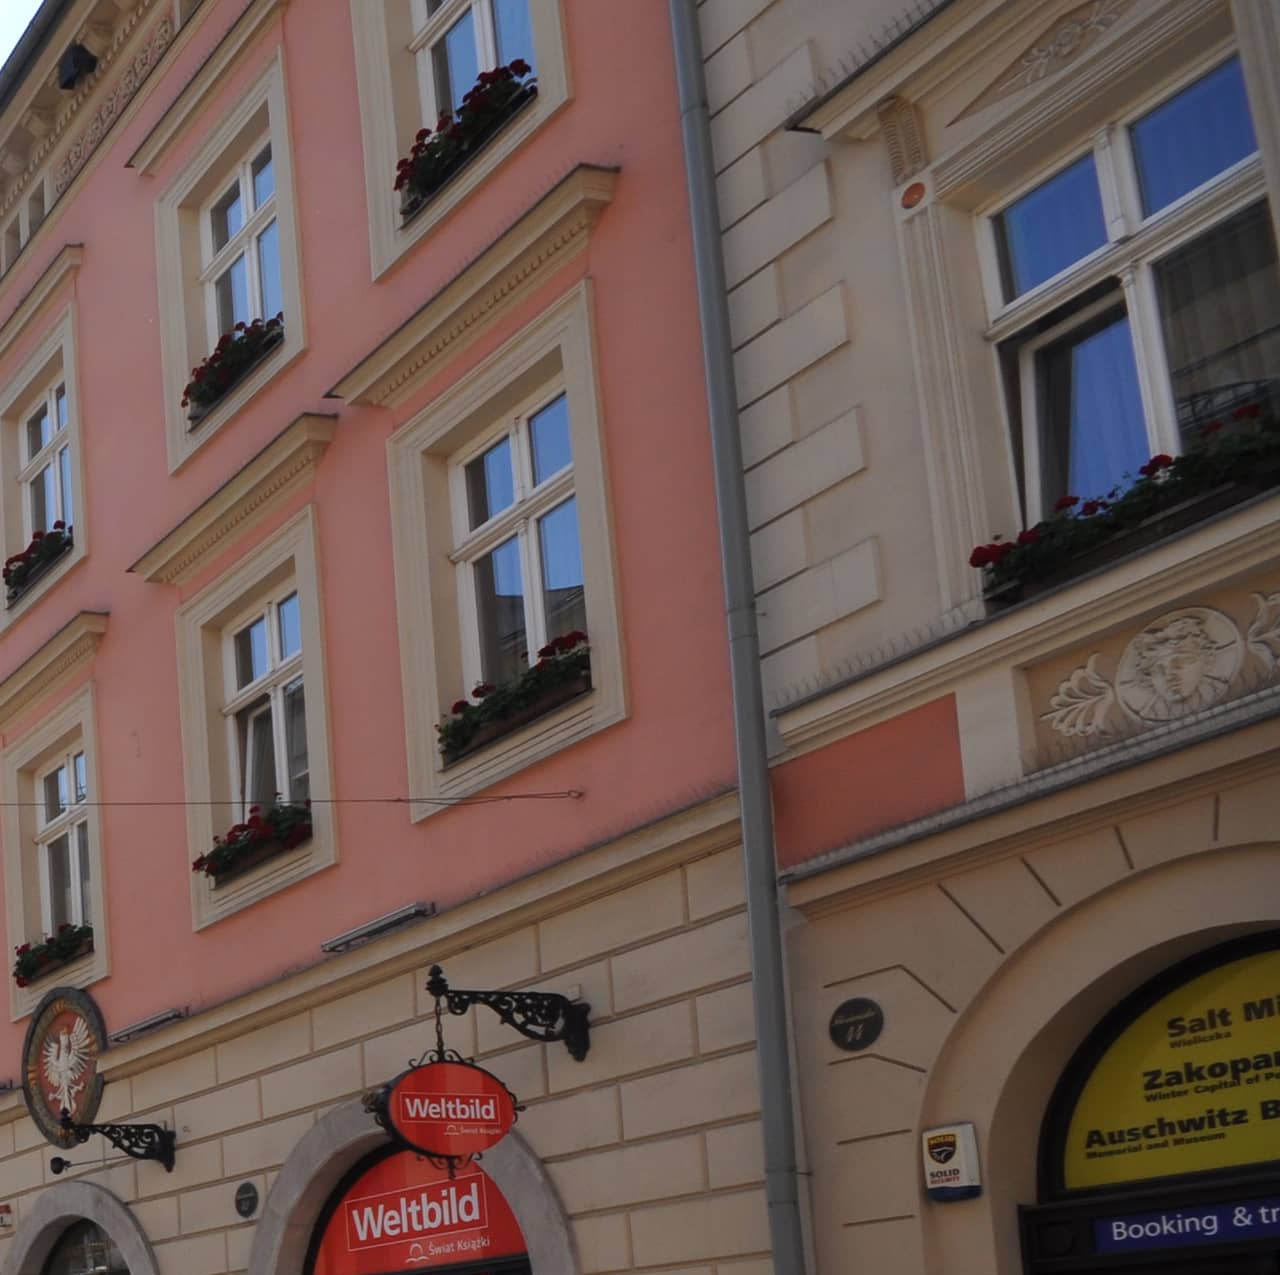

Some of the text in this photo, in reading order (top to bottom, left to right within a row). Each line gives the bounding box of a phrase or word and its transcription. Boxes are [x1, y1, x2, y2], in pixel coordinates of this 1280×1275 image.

[1167, 1008, 1232, 1038] Salt
[1170, 1031, 1232, 1048] Wieliczka
[1145, 1089, 1188, 1102] Winter
[1194, 1080, 1240, 1094] Capital
[1246, 1075, 1259, 1085] of
[405, 1097, 496, 1120] Weltbild
[1086, 1108, 1248, 1148] Auschwitz
[1086, 1132, 1226, 1159] Memorial and Museum
[930, 1168, 960, 1179] SOLID
[352, 1182, 480, 1241] Weltbild
[1112, 1214, 1218, 1240] Booking
[1233, 1206, 1253, 1227] &
[428, 1241, 455, 1256] Świat
